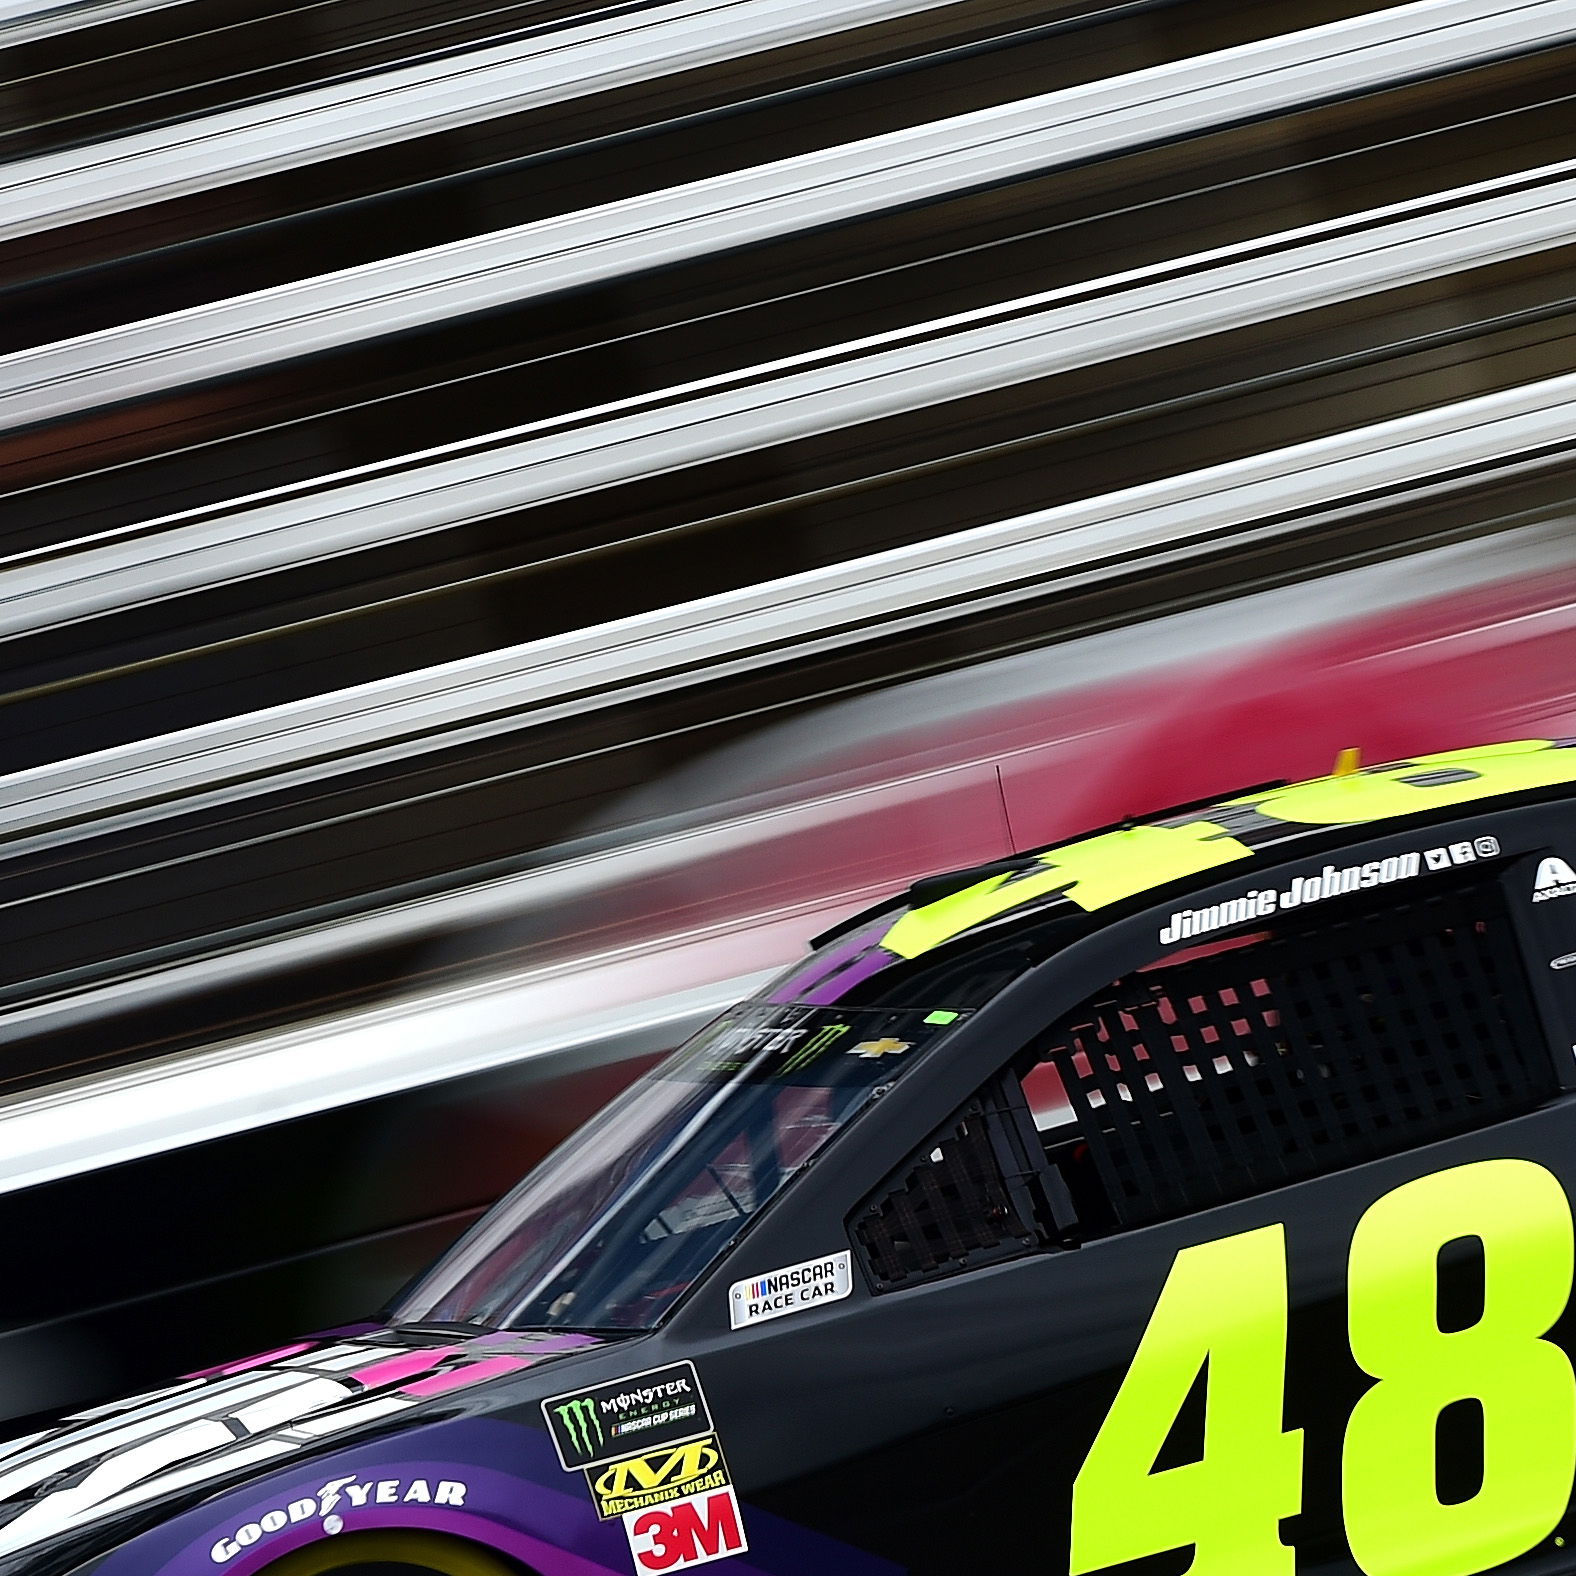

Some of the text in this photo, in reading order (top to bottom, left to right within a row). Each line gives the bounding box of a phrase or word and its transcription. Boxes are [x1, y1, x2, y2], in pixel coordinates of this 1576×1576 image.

[1160, 852, 1420, 944] Jimmie Johnson
[767, 1261, 834, 1295] NASCAR
[749, 1281, 835, 1317] RACE CAR
[601, 1378, 691, 1414] MONSTER
[619, 1398, 681, 1420] ENERGY
[652, 1410, 670, 1426] CUP
[601, 1469, 726, 1517] MECHANIX WEAR
[210, 1477, 468, 1563] GOODYEAR
[634, 1491, 742, 1570] 3M
